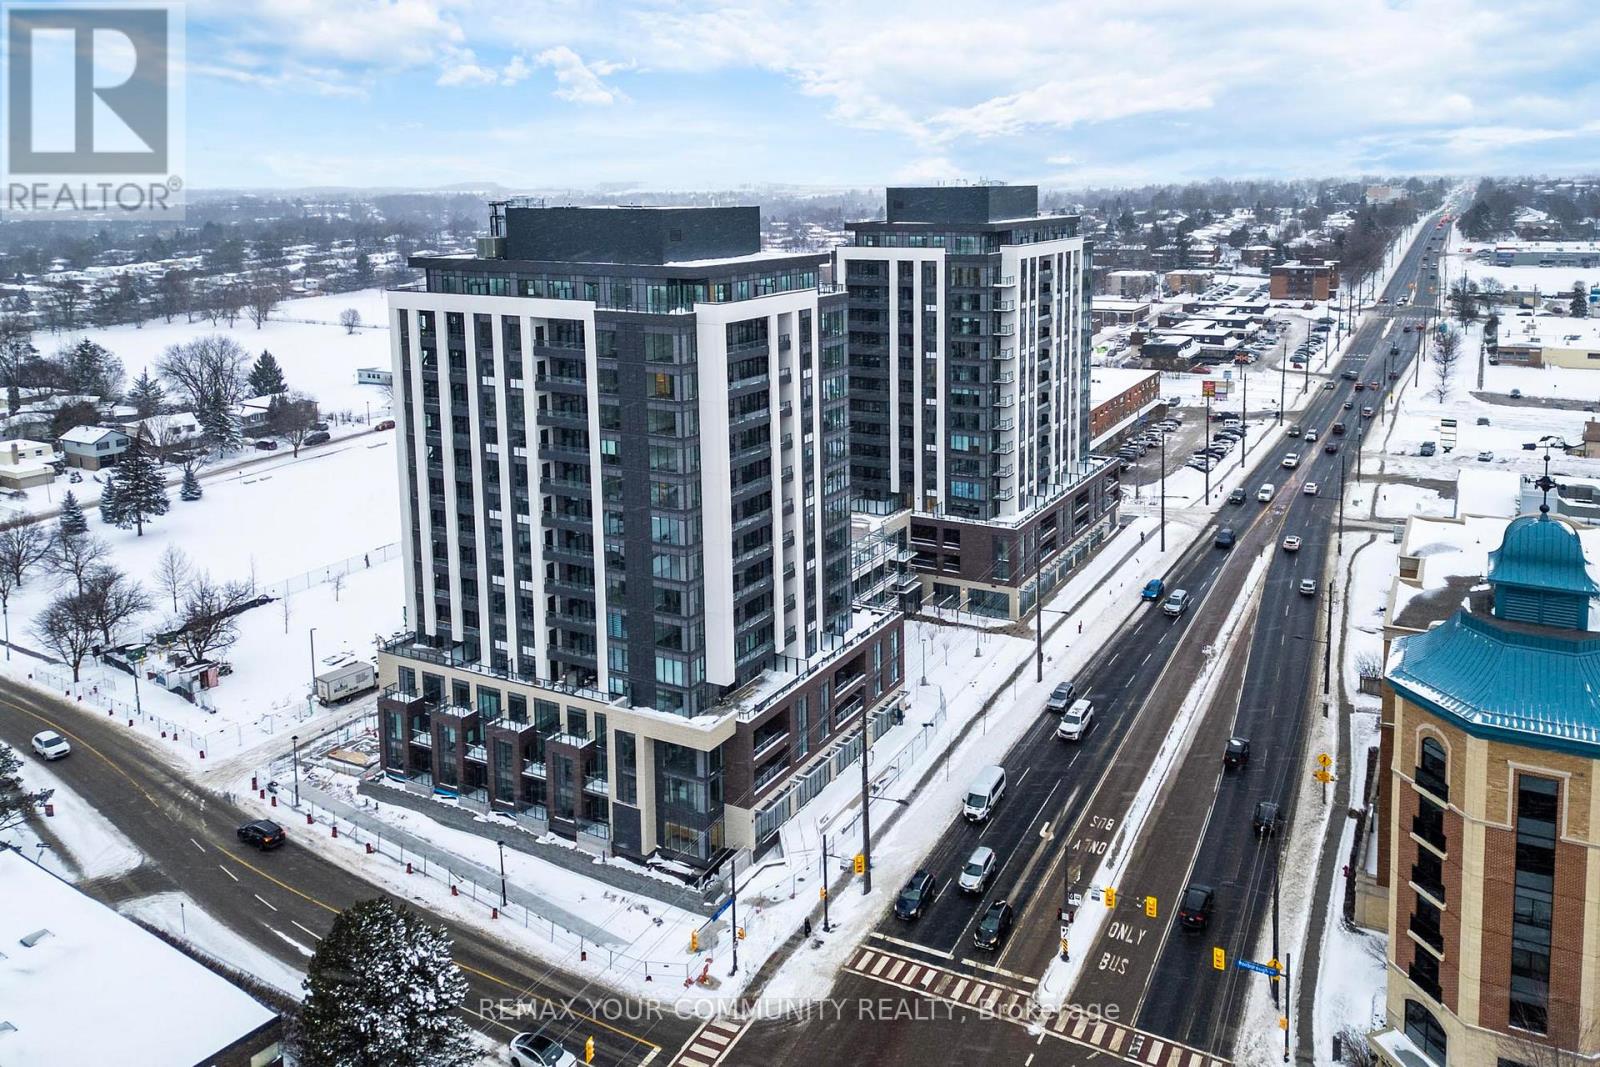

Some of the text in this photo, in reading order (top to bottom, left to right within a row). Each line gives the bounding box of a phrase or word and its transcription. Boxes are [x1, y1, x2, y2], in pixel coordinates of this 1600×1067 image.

[1090, 815, 1115, 831] BUS
[1073, 839, 1108, 855] ONLY
[1109, 921, 1147, 945] ONLY
[1099, 952, 1129, 974] BUS
